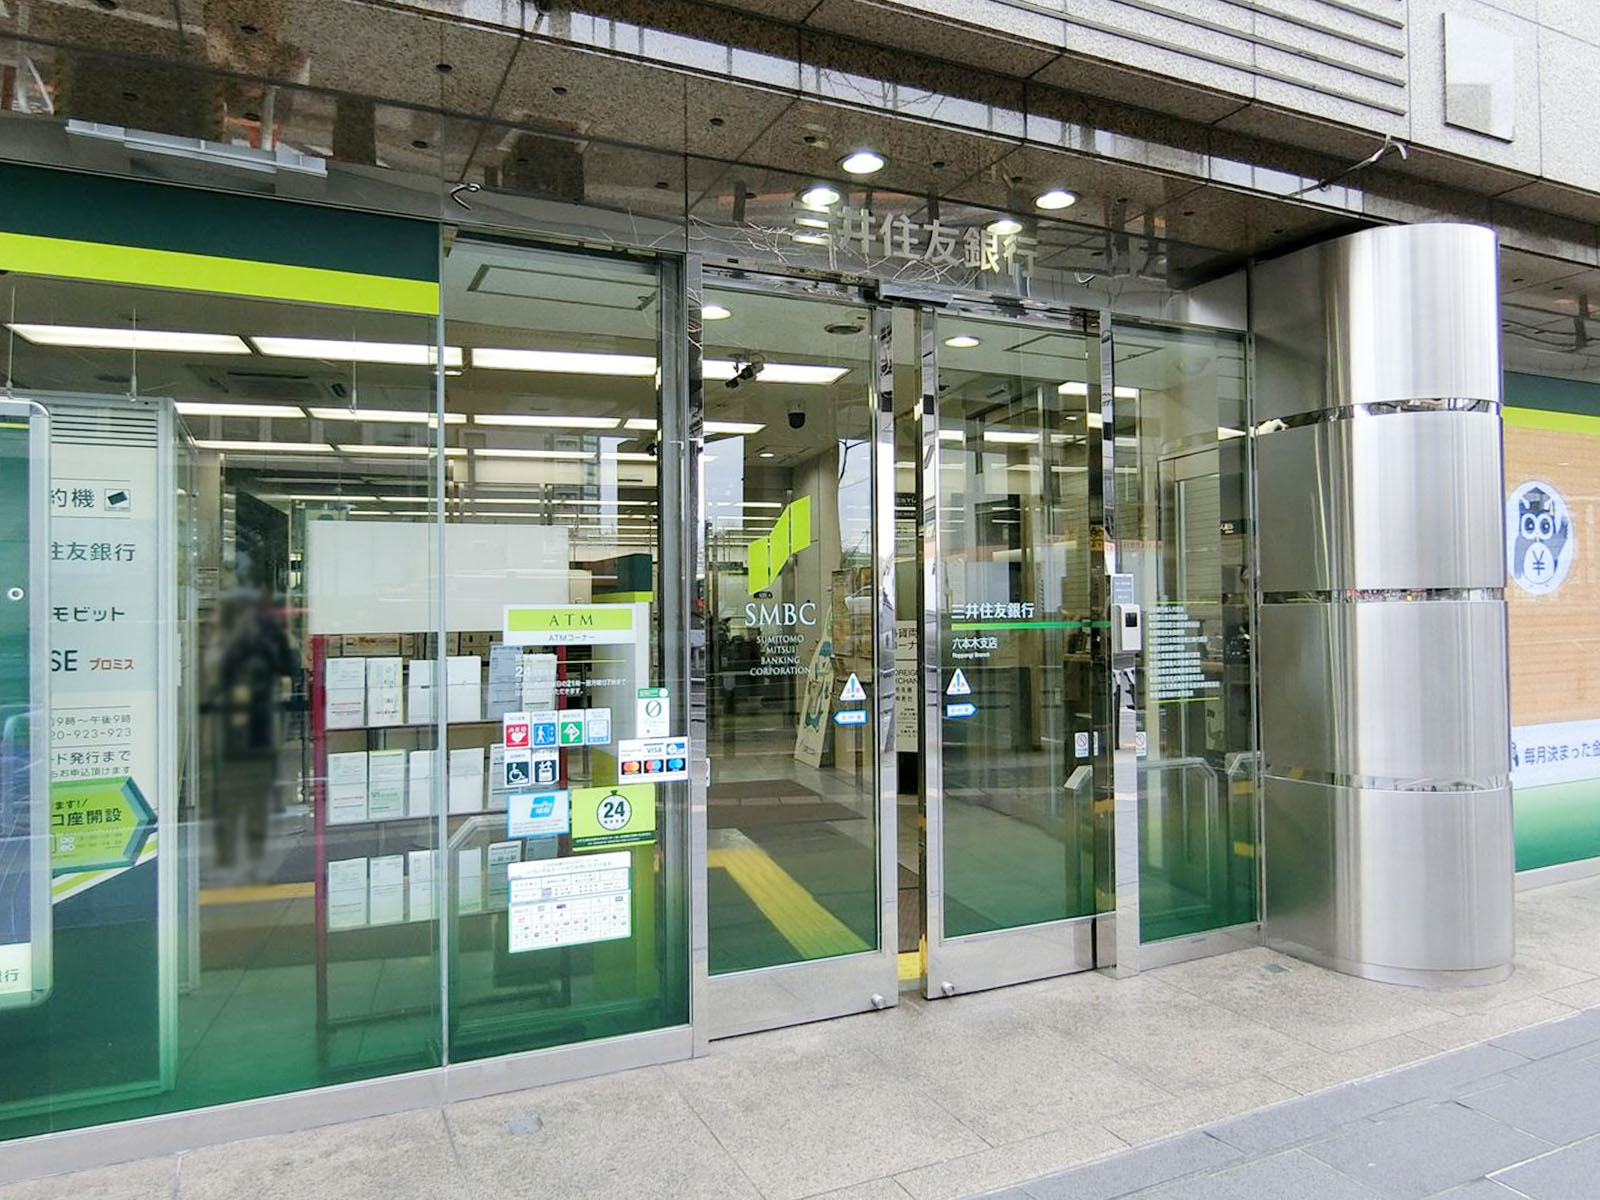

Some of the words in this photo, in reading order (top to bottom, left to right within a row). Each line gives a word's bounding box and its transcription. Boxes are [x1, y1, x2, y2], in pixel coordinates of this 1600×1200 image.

[791, 202, 1038, 277] 三井住友銀行
[53, 606, 125, 622] モビット
[744, 602, 817, 627] SMBC
[951, 602, 1034, 619] 三井住友銀行
[549, 613, 594, 626] ATM
[548, 634, 596, 642] ATMコーナー
[756, 634, 805, 645] SUMITOMO
[952, 636, 998, 650] 六本木支店
[766, 646, 796, 655] MITSUI
[89, 657, 134, 671] プロミス
[760, 655, 800, 665] BANKING
[749, 665, 812, 676] CORPORATION
[603, 801, 626, 819] 24
[0, 968, 20, 982] 行
